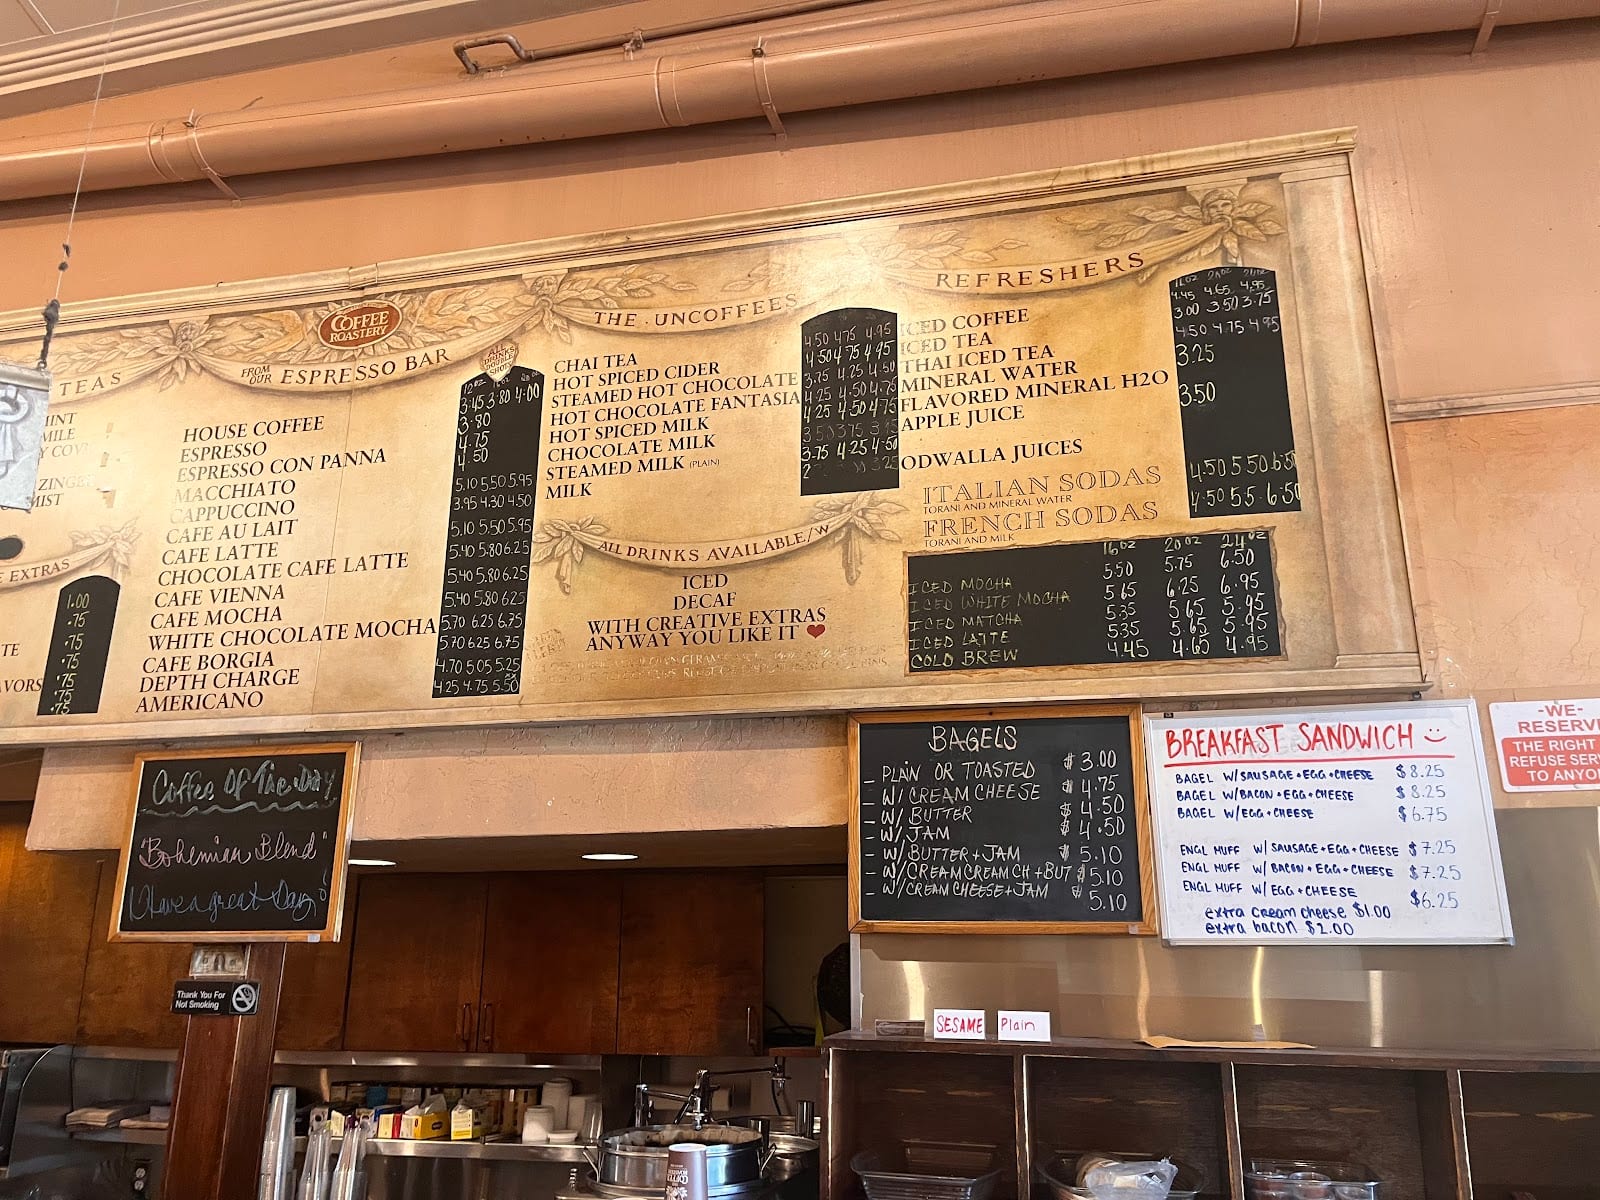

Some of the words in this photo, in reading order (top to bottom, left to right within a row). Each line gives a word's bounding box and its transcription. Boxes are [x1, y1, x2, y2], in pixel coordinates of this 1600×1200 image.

[936, 252, 1145, 288] REFRESHERS
[331, 311, 389, 332] COFFEE
[594, 311, 637, 327] THE
[655, 293, 799, 326] UNCOFFEES
[329, 325, 389, 342] ROASTERY
[900, 319, 946, 336] ICED
[953, 308, 1030, 330] COFFEE
[900, 338, 947, 355] ICED
[953, 331, 993, 349] TEA
[281, 361, 396, 384] ESPRESSO
[405, 348, 450, 371] BAR
[554, 357, 598, 374] CHAI
[604, 353, 638, 369] TEA
[900, 354, 952, 374] THAI
[958, 348, 1006, 367] ICED
[1012, 344, 1054, 361] TEA
[242, 364, 271, 378] FROM
[250, 373, 272, 385] OUR
[553, 375, 594, 391] HOT
[598, 368, 659, 387] SPICED
[664, 361, 720, 380] CIDER
[901, 370, 995, 393] MINERAL
[1001, 360, 1078, 381] WATER
[60, 371, 122, 397] TEAS
[551, 388, 632, 409] STEAMED
[637, 382, 678, 400] HOT
[683, 372, 798, 395] CHOCOLATE
[901, 387, 1009, 413] FLAVORED
[1016, 376, 1116, 400] MINERAL
[1121, 369, 1169, 388] H2O
[550, 409, 591, 427] HOT
[594, 397, 705, 423] CHOCOLATE
[711, 391, 801, 412] FANTASIA
[901, 410, 961, 432] APPLE
[966, 405, 1025, 429] JUICE
[183, 423, 248, 443] HOUSE
[253, 415, 325, 437] COFFEE
[549, 427, 591, 444] HOT
[595, 421, 657, 440] SPICED
[662, 416, 710, 434] MILK
[179, 441, 267, 463] ESPRESSO
[548, 439, 662, 463] CHOCOLATE
[668, 434, 716, 452] MILK
[901, 447, 1006, 470] ODWALLA
[1011, 439, 1083, 463] JUICES
[177, 461, 264, 483] ESPRESSO
[270, 456, 315, 474] CON
[320, 448, 387, 470] PANNA
[546, 460, 632, 481] STEAMED
[637, 455, 685, 474] MILK
[174, 479, 296, 504] MACCHIATO
[545, 483, 592, 500] MILK
[923, 475, 1050, 505] ITALIAN
[1059, 465, 1162, 492] SODAS
[169, 499, 295, 524] CAPPUCCINO
[924, 504, 961, 515] TORANI
[964, 502, 986, 511] AND
[989, 498, 1033, 509] MINERAL
[1036, 494, 1073, 505] WATER
[924, 510, 1045, 538] FRENCH
[1056, 501, 1158, 527] SODAS
[166, 526, 214, 545] CAFE
[218, 523, 247, 541] AU
[252, 518, 299, 538] LAIT
[924, 536, 961, 548] TORANI
[964, 534, 987, 544] AND
[990, 533, 1015, 543] MILK
[162, 547, 210, 566] CAFE
[216, 542, 279, 562] LATTE
[598, 540, 623, 556] ALL
[627, 545, 699, 562] DRINKS
[9, 559, 70, 582] EXTRAS
[158, 562, 282, 587] CHOCOLATE
[287, 558, 336, 578] CAFE
[344, 552, 409, 573] LATTE
[682, 573, 728, 590] ICED
[961, 577, 1013, 591] MOCHA
[154, 589, 203, 608] CAFE
[210, 584, 285, 605] VIENNA
[673, 592, 736, 611] DECAF
[150, 611, 199, 630] CAFE
[204, 606, 282, 626] MOCHA
[587, 618, 641, 636] WITH
[646, 611, 742, 632] CREATIVE
[748, 607, 826, 626] EXTRAS
[962, 611, 1023, 627] MATCHA
[149, 632, 214, 651] WHITE
[220, 623, 348, 647] CHOCOLATE
[354, 617, 437, 639] MOCHA
[586, 632, 673, 652] ANYWAY
[679, 628, 722, 646] YOU
[728, 626, 772, 643] LIKE
[777, 624, 800, 641] IT
[962, 631, 1011, 646] LATTE
[142, 655, 191, 674] CAFE
[198, 651, 275, 671] BORGIA
[911, 653, 954, 668] COLD
[961, 649, 1018, 666] BREW
[139, 673, 207, 693] DEPTH
[213, 668, 300, 689] CHARGE
[135, 691, 263, 714] AMERICANO
[1518, 718, 1600, 734] RESERV
[928, 725, 1018, 752] BAGELS
[1165, 724, 1284, 759] BREAKFAST
[1297, 722, 1413, 753] SANDWICH
[1512, 740, 1545, 753] THE
[1548, 738, 1596, 751] RIGHT
[934, 762, 954, 781] OR
[962, 761, 1036, 780] TOASTED
[1509, 754, 1567, 768] REFUSE
[1175, 773, 1214, 784] BAGEL
[1527, 770, 1549, 782] TO
[1553, 768, 1600, 782] ANYO
[909, 785, 969, 806] CREAM
[974, 782, 1041, 801] CHEESE
[1176, 789, 1216, 801] BAGEL
[908, 805, 973, 826] BUTTER
[1177, 807, 1216, 820] BAGEL
[1213, 844, 1240, 856] MUFF
[1214, 862, 1241, 873] MUFF
[1205, 906, 1245, 919] extra
[1300, 904, 1347, 919] cheese
[1352, 902, 1391, 920] $1.00
[1205, 921, 1247, 935] extra
[1254, 919, 1298, 935] bacon
[1307, 920, 1355, 936] $2.00
[175, 1000, 188, 1009] Not
[188, 1000, 220, 1011] Smoking
[176, 990, 198, 999] Thank
[200, 990, 212, 999] You
[213, 990, 226, 999] For
[936, 1014, 983, 1034] SESAME
[1001, 1018, 1036, 1032] Plain
